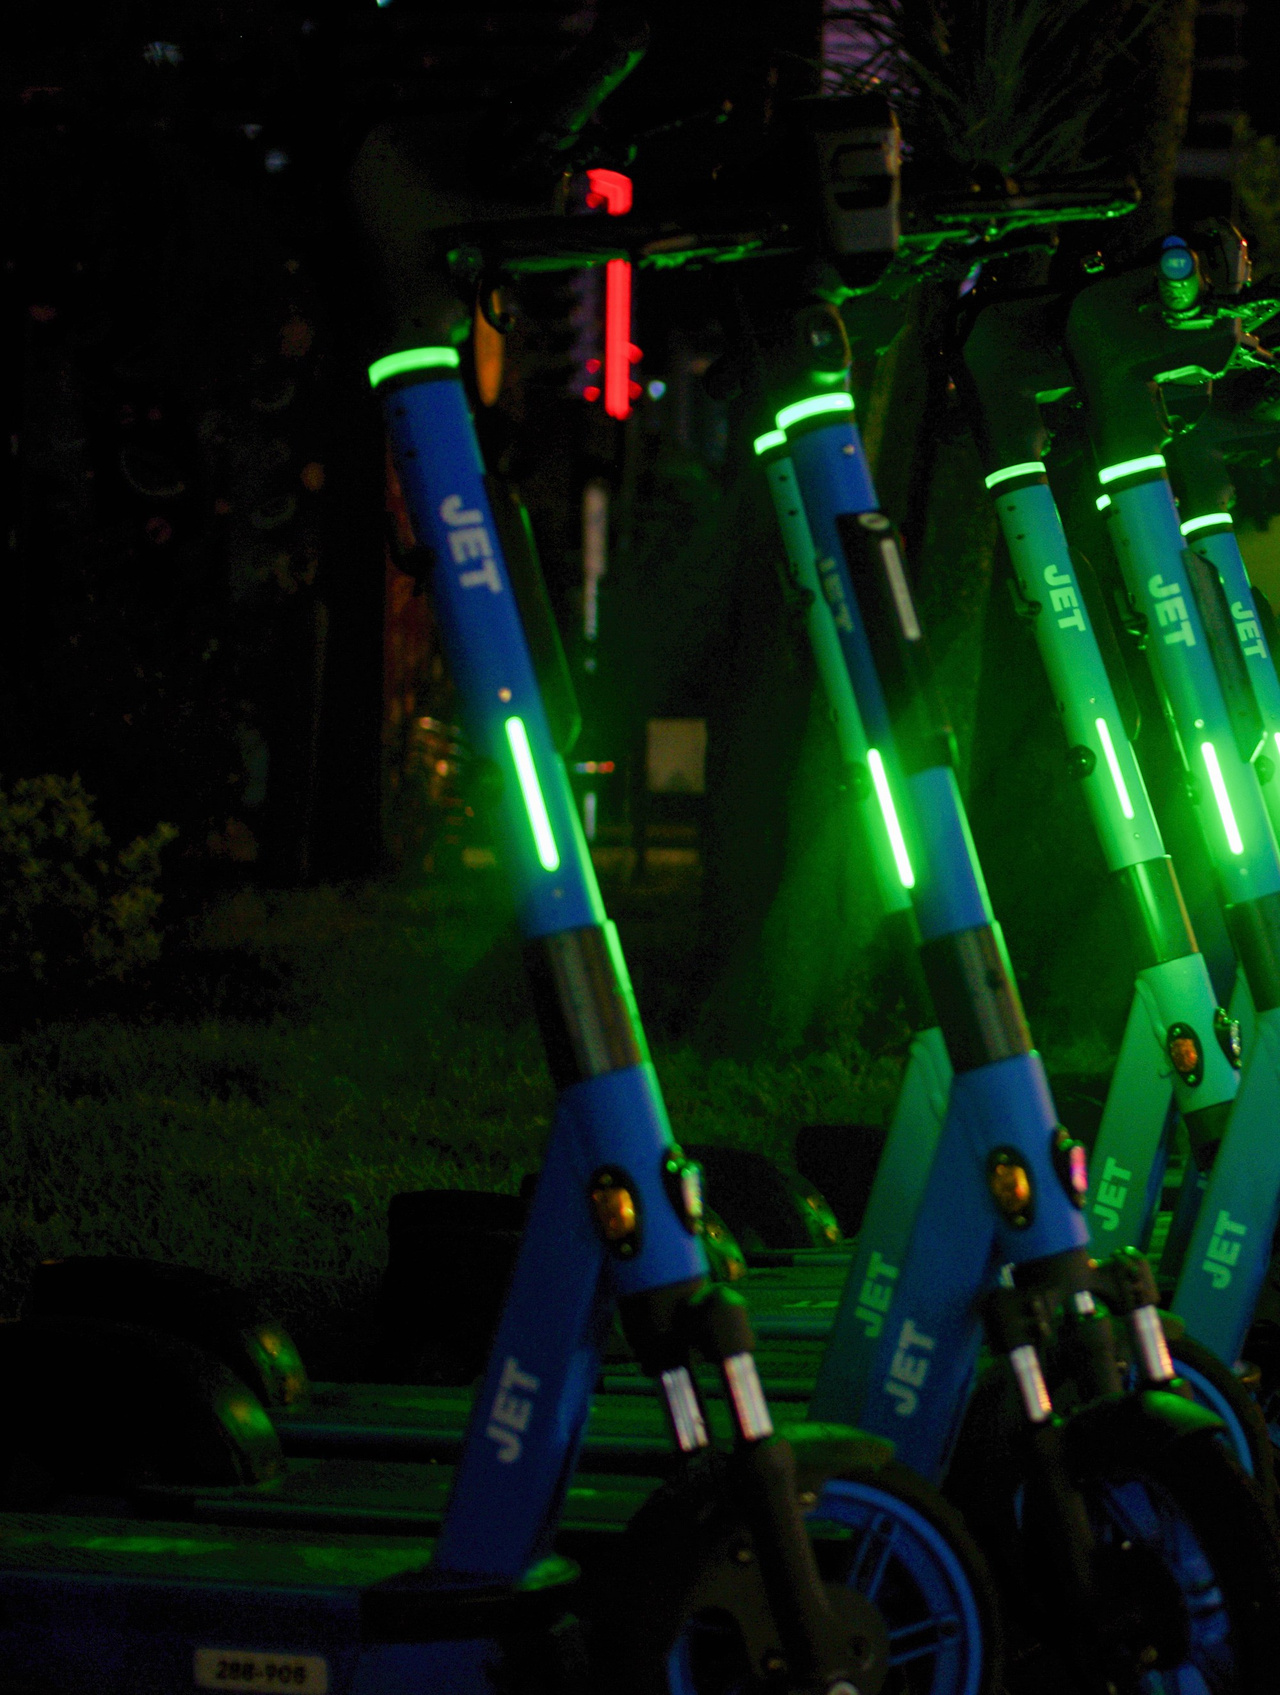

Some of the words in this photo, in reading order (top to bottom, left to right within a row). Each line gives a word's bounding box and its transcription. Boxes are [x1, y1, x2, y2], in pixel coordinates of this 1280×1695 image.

[441, 494, 502, 593] JET
[1043, 564, 1086, 631] JET
[1148, 574, 1196, 647] JET
[1231, 601, 1267, 659] JET
[1093, 1156, 1133, 1231] JET
[1202, 1210, 1248, 1290] JET
[855, 1251, 899, 1338] JET
[884, 1319, 936, 1416] JET
[485, 1356, 541, 1463] JET
